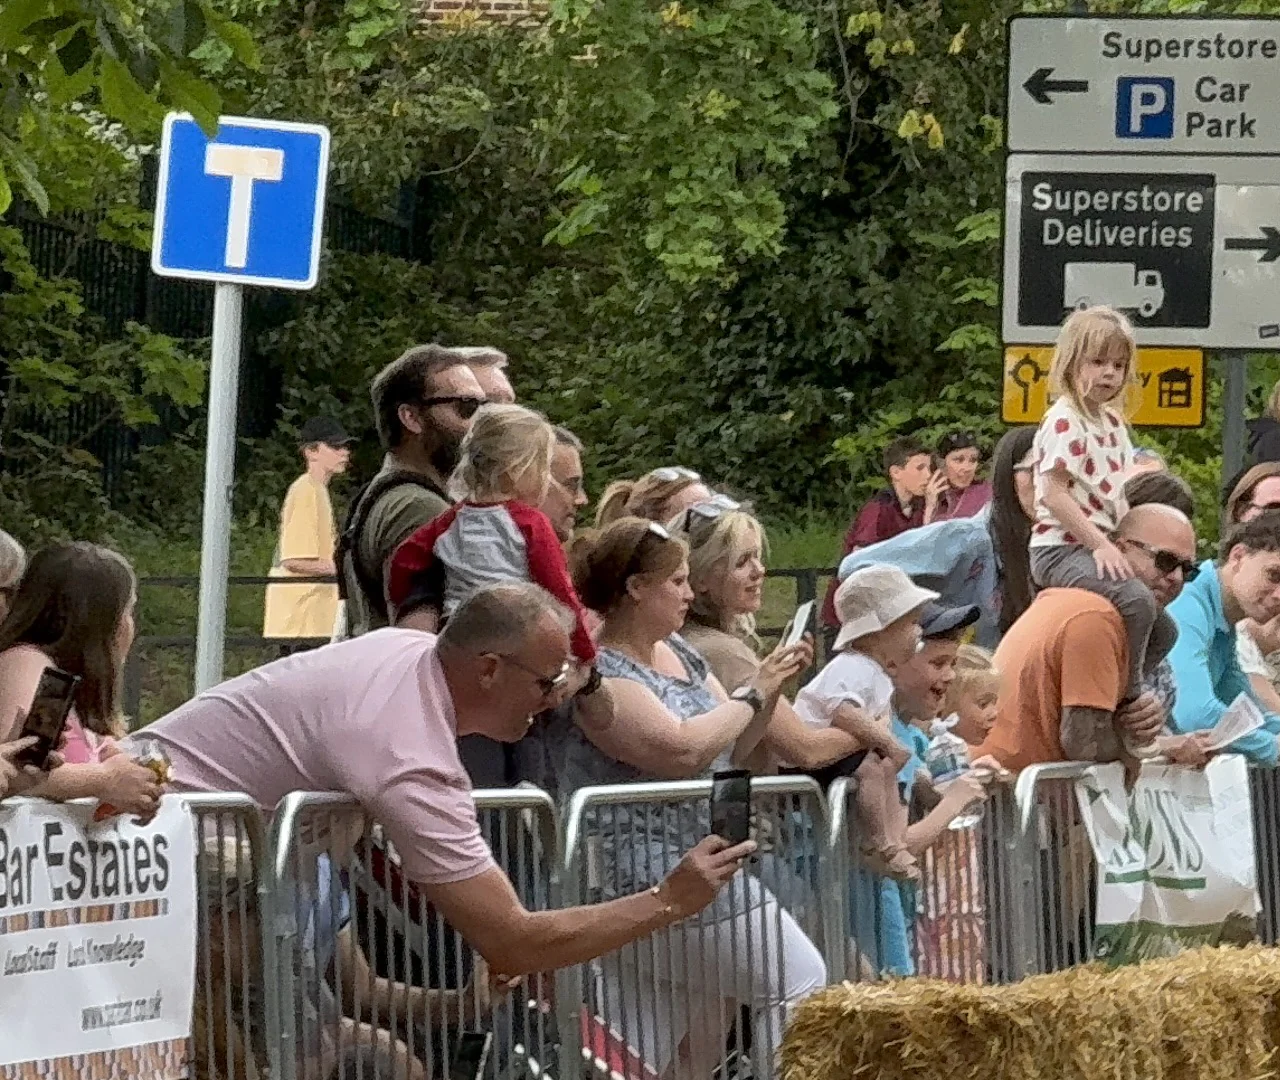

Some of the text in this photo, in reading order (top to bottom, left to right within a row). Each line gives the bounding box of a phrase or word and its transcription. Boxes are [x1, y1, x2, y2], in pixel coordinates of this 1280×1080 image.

[1102, 31, 1278, 63] Superstore
[1195, 76, 1251, 103] Car
[1129, 83, 1167, 133] P
[1186, 112, 1257, 138] Park
[1031, 182, 1204, 216] Superstore
[1042, 218, 1193, 248] Deliveries
[43, 821, 170, 902] Estates
